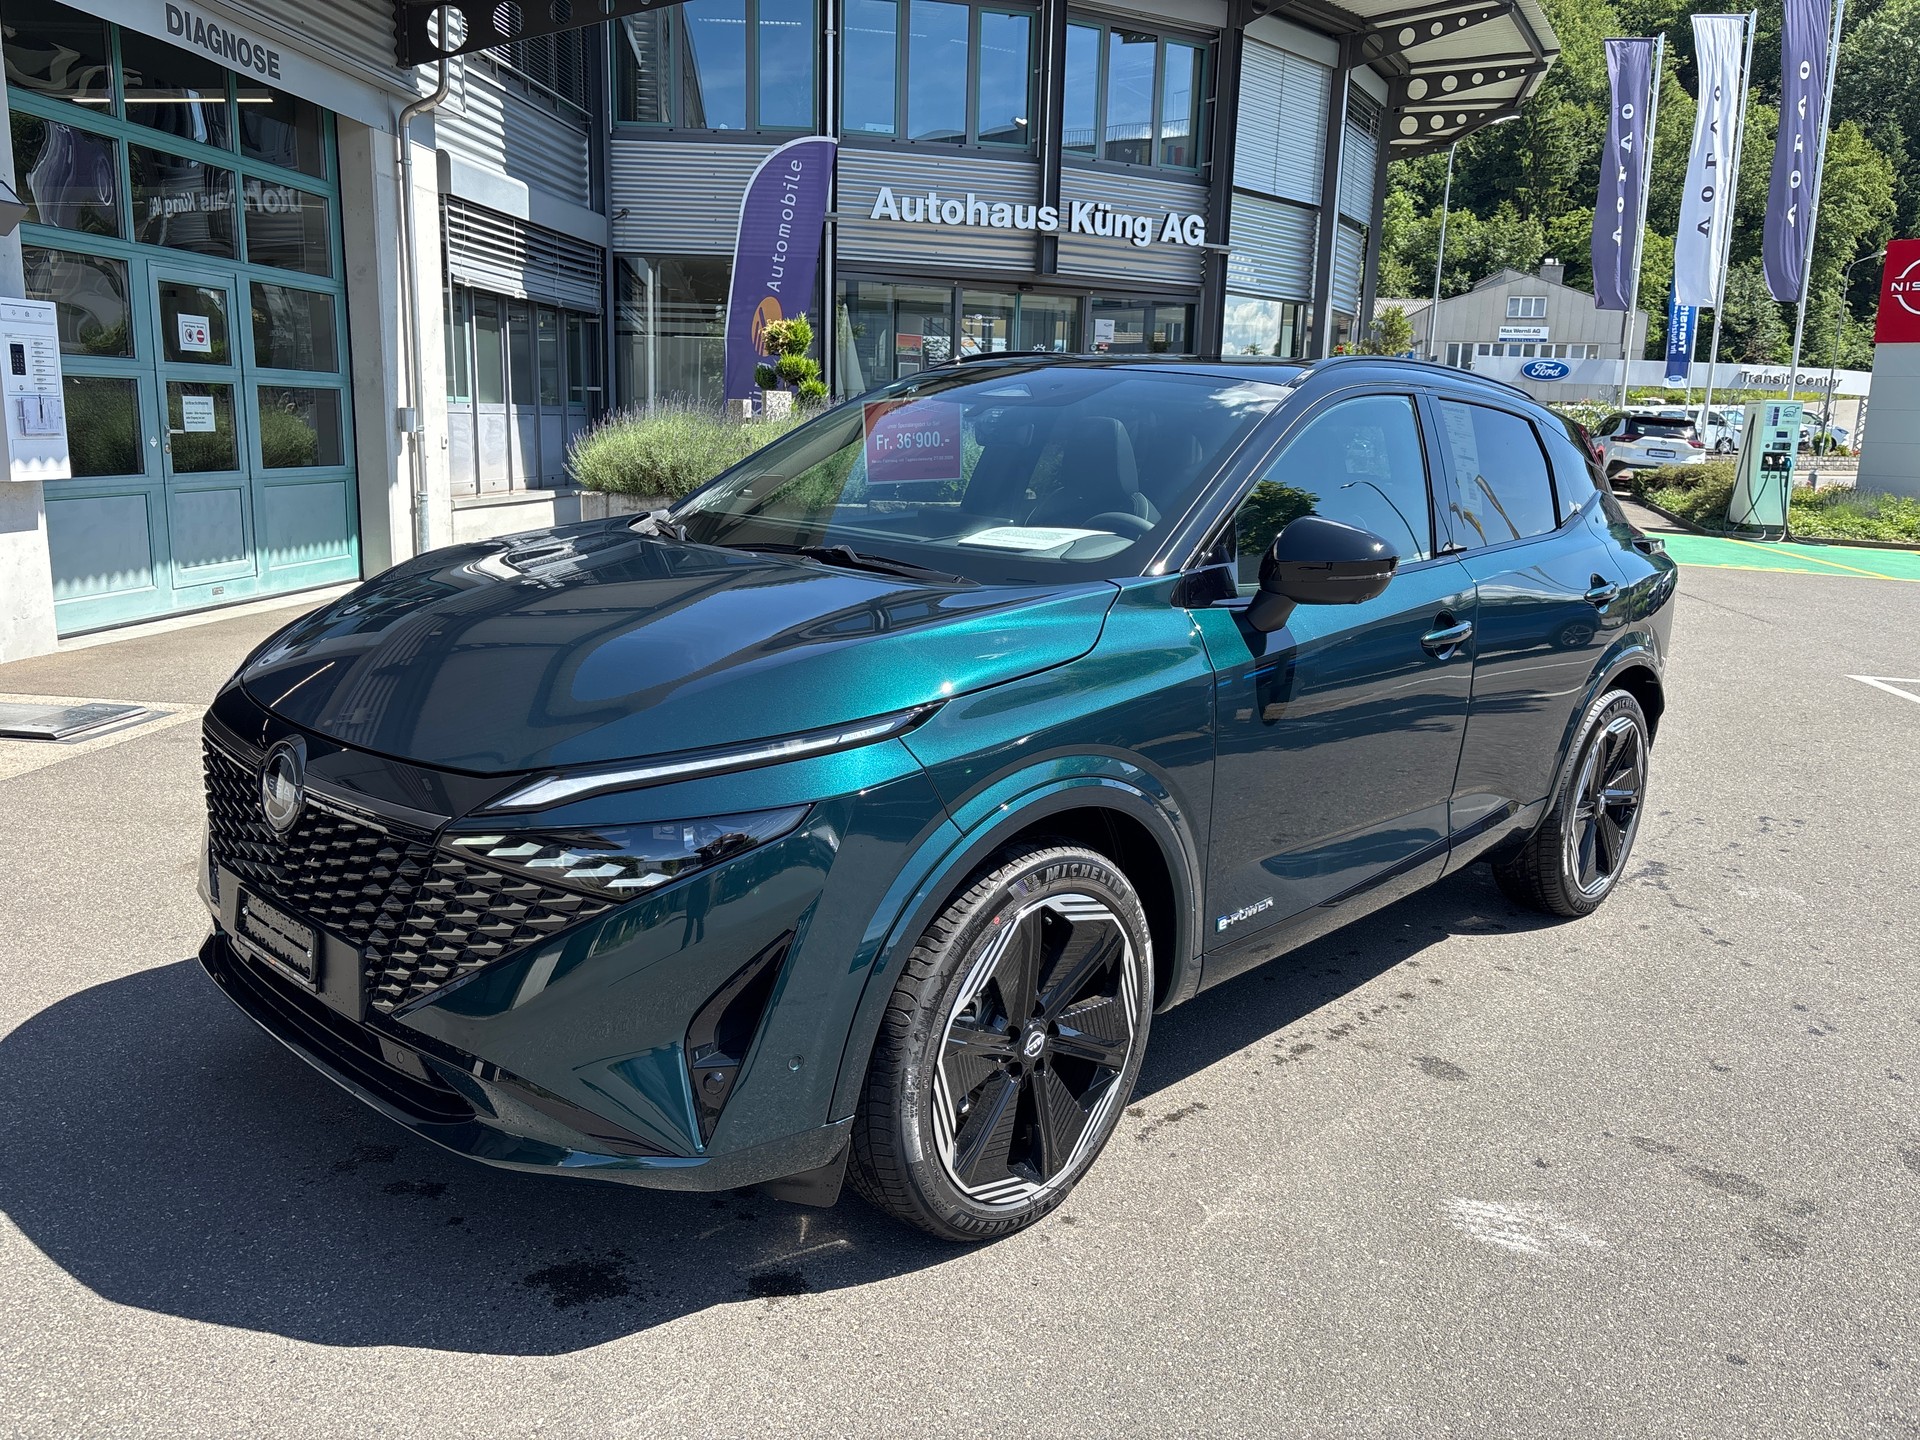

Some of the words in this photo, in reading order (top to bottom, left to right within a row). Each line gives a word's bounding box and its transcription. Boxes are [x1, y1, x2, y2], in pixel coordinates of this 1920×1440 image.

[165, 2, 281, 81] DIAGNOSE
[766, 159, 803, 293] Automobile
[870, 186, 1059, 232] Autohaus
[1068, 200, 1153, 248] Küng
[1160, 212, 1206, 247] AG
[1530, 361, 1562, 377] Ford
[1740, 371, 1791, 385] Transit
[1795, 373, 1843, 388] Center
[876, 434, 893, 451] Fr.
[1045, 863, 1127, 897] MICHELIN
